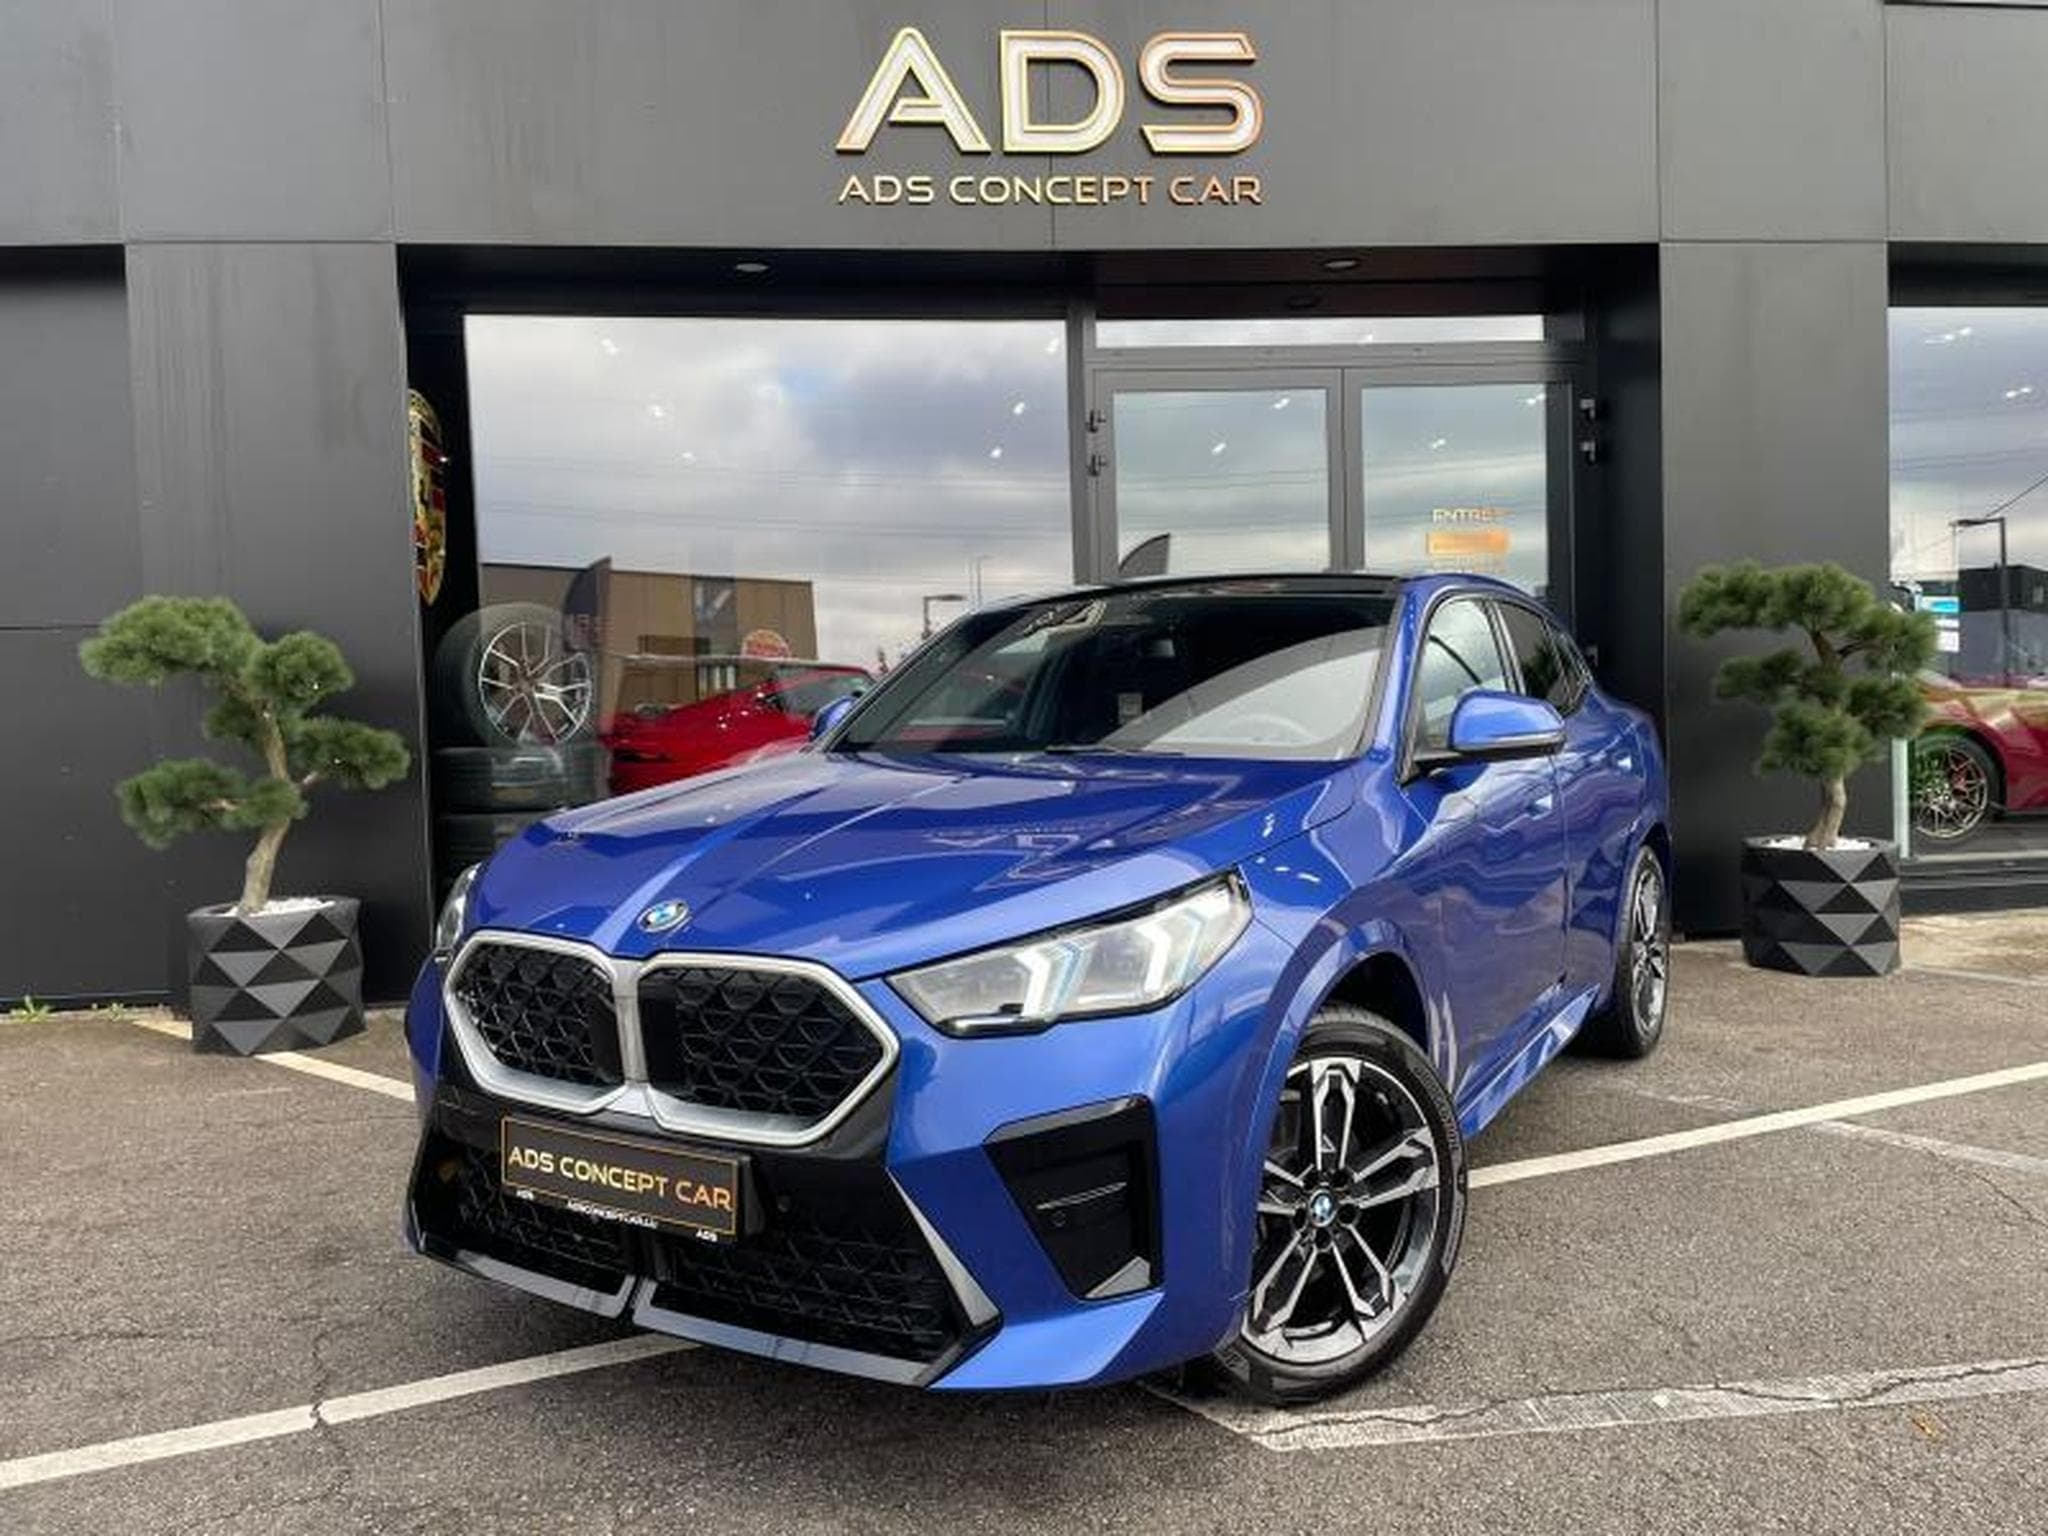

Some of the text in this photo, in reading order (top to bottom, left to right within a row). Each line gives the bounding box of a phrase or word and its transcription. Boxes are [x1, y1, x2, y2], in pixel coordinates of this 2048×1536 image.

[835, 26, 1264, 153] ADS
[838, 175, 1263, 205] ADS CONCEPT CAR
[508, 1146, 733, 1211] ADS CONCEPT CAR
